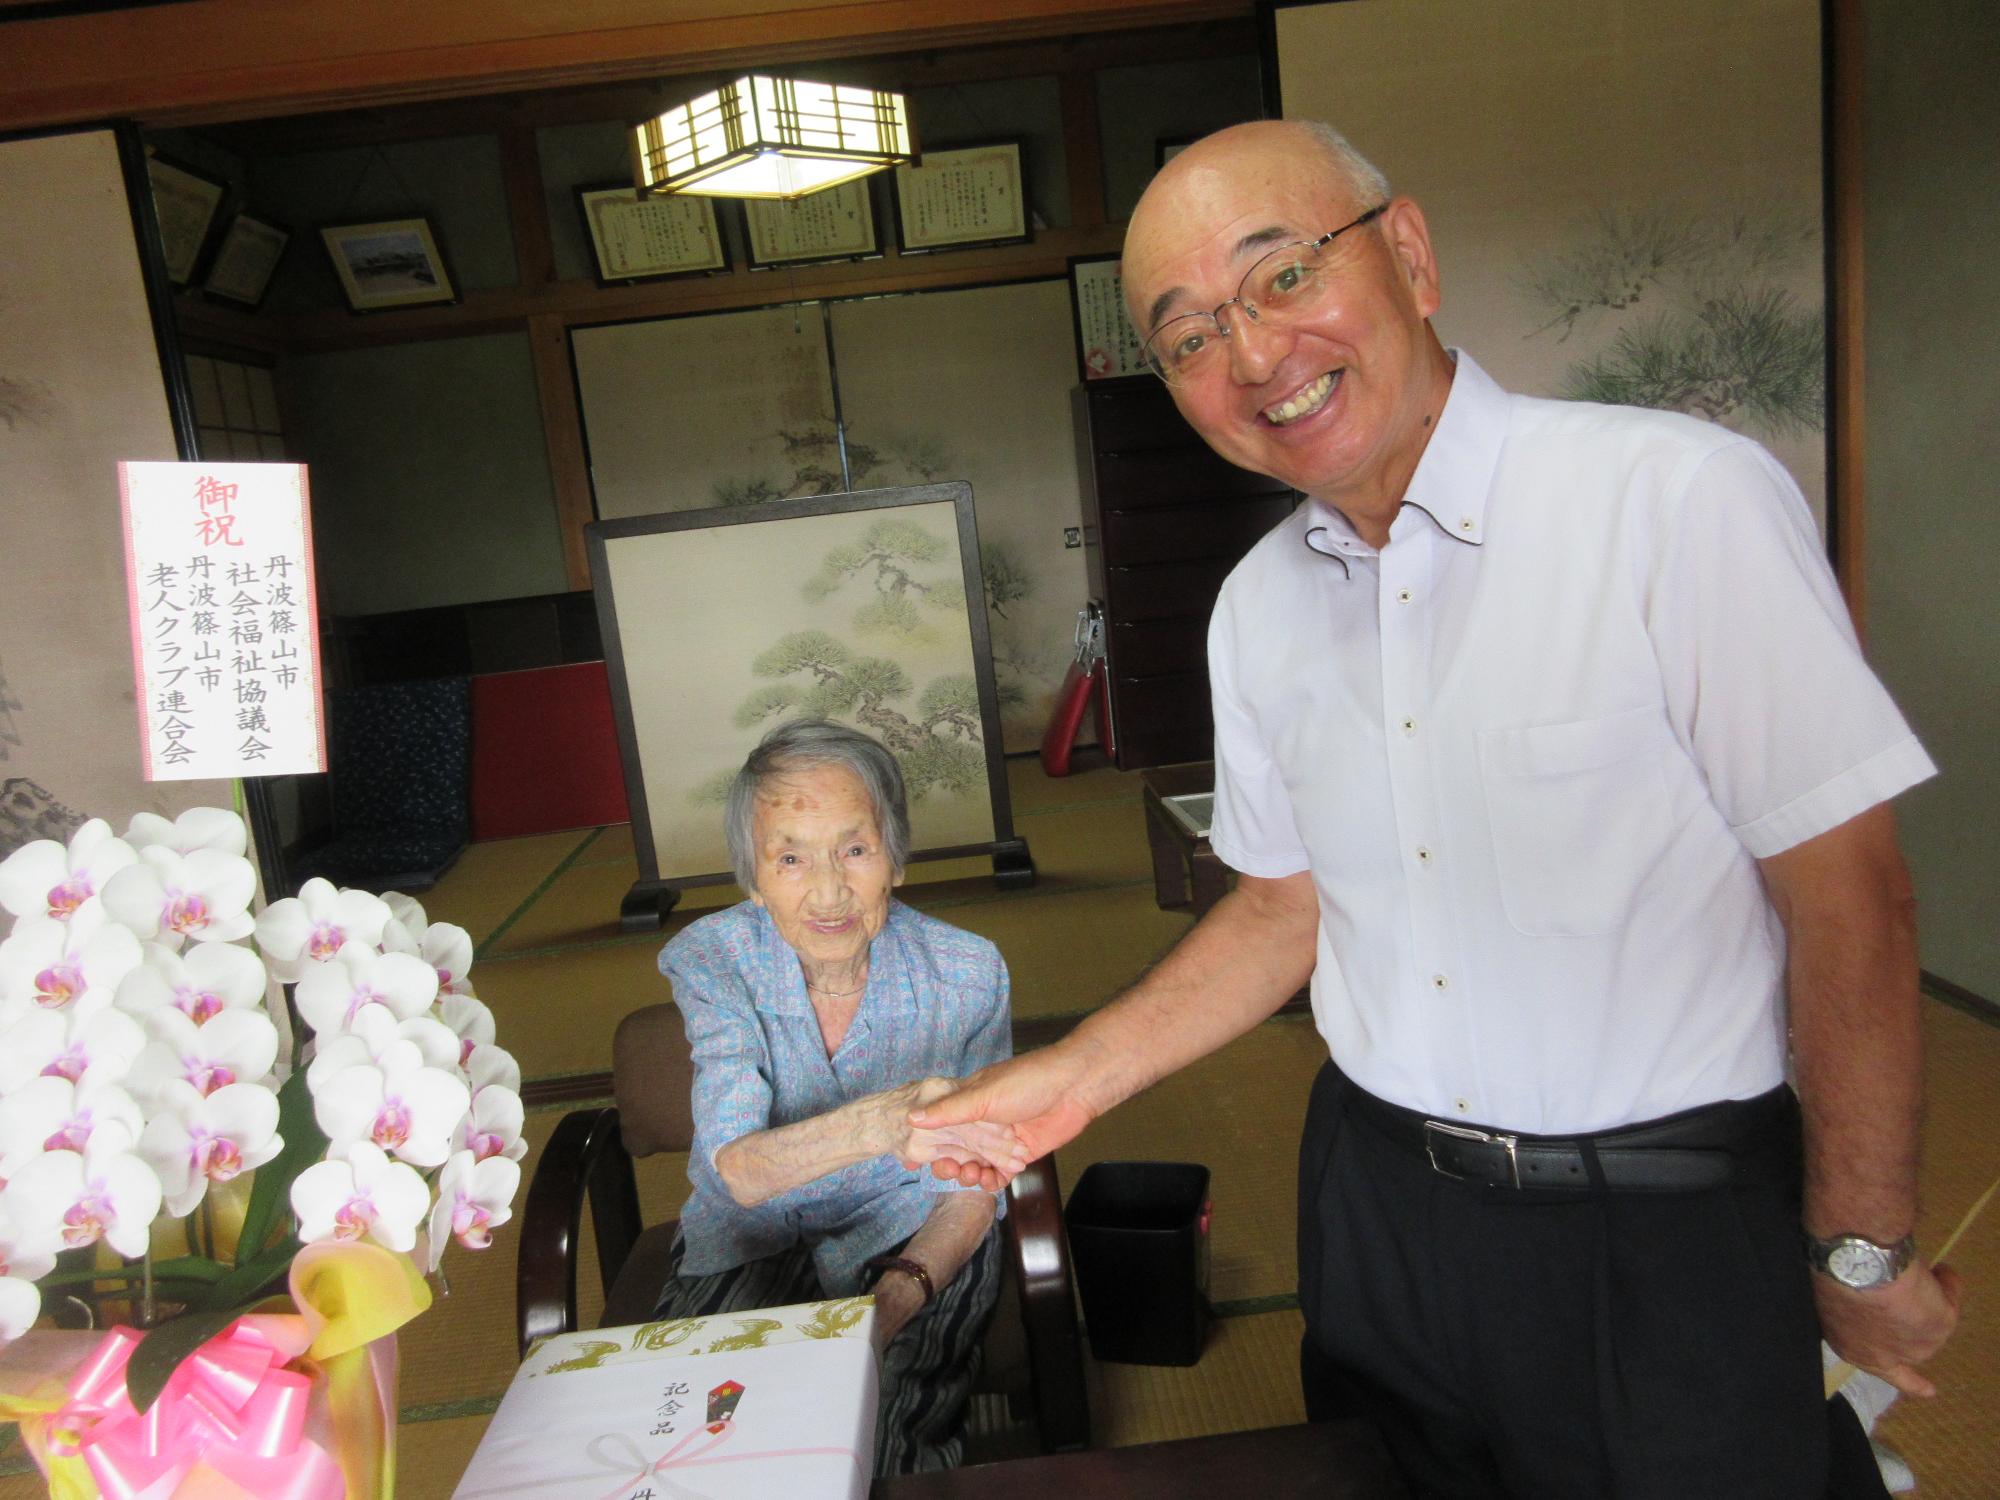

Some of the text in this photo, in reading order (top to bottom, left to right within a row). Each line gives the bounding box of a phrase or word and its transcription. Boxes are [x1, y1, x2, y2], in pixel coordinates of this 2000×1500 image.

[194, 475, 244, 546] 御祝
[147, 562, 197, 764] 老人クラブ連合会
[186, 555, 221, 692] 丹波篠山市
[226, 562, 273, 761] 社会福祉協議会
[264, 555, 298, 690] 丹波篠山市
[649, 1382, 690, 1435] 記念品
